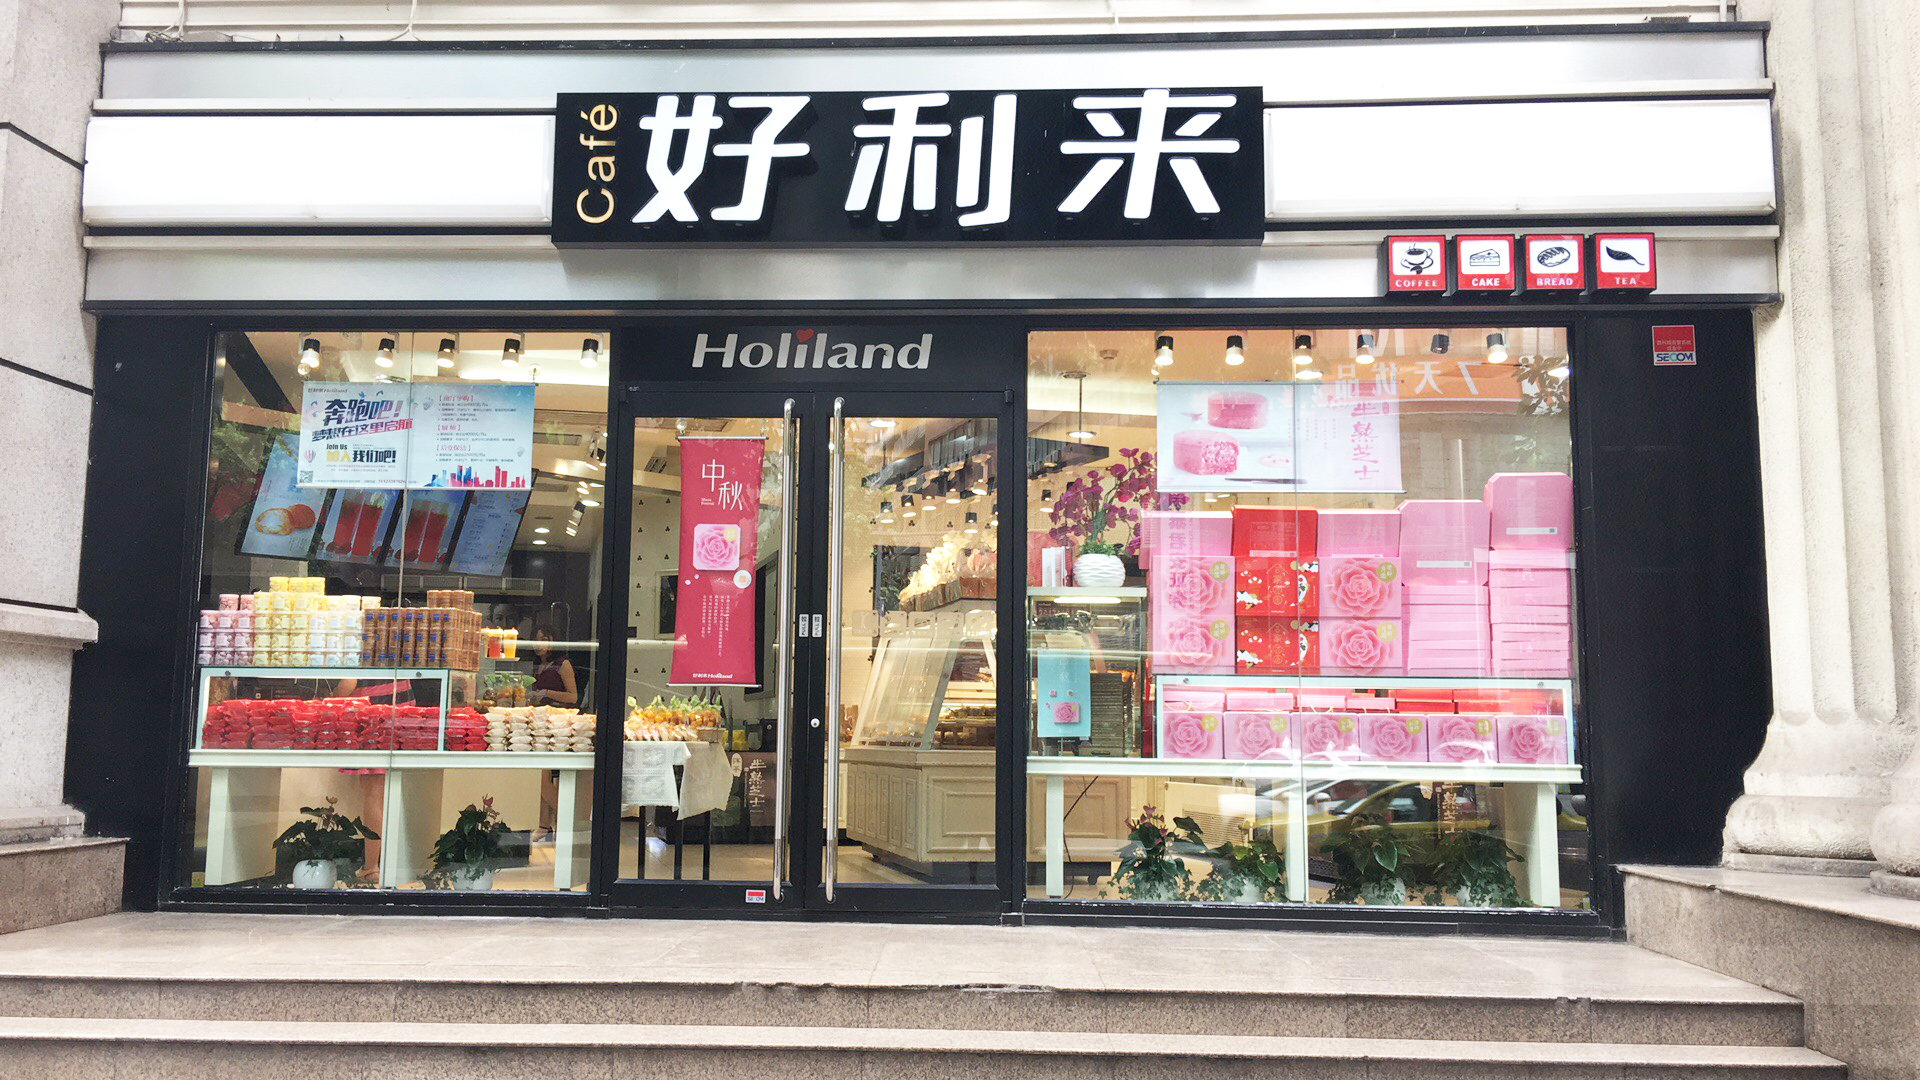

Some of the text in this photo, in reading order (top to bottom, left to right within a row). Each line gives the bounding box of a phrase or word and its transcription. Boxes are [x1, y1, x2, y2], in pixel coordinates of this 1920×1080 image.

[576, 103, 619, 224] Café
[631, 88, 1240, 227] 好利来
[1395, 279, 1438, 288] COFFEE
[1471, 277, 1500, 287] CAKE
[1536, 277, 1574, 287] BREAD
[1614, 276, 1637, 285] TEA
[692, 328, 933, 369] Holiland
[1656, 352, 1694, 362] SECOM
[312, 418, 413, 442] 梦想在这里启航
[1351, 401, 1379, 480] 半熟芝士
[702, 458, 743, 510] 中秋
[748, 759, 767, 807] 半熟芝士
